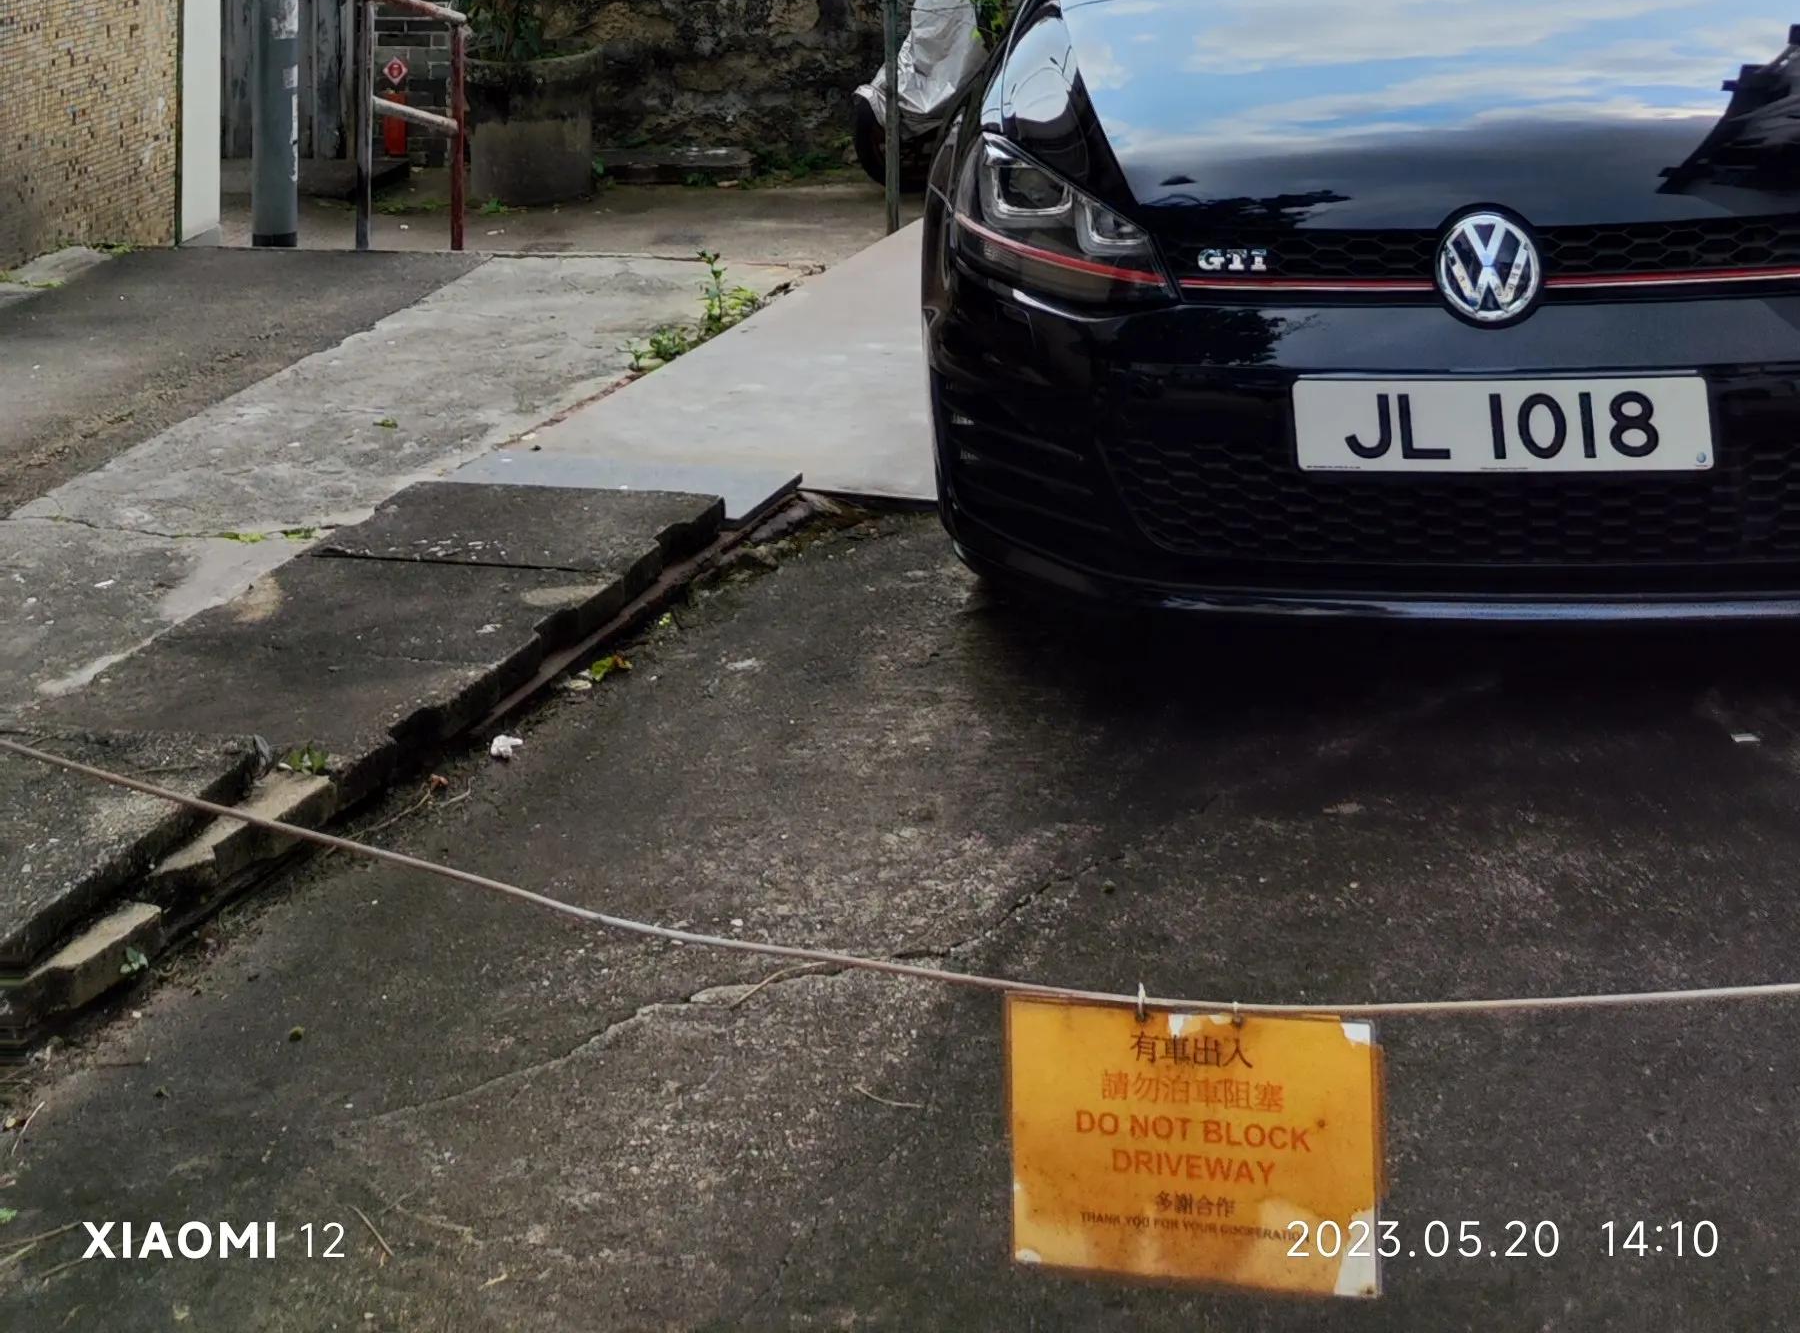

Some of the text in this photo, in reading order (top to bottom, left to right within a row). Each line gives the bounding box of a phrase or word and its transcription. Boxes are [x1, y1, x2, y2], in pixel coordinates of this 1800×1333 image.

[1197, 248, 1267, 271] GTI
[1344, 391, 1660, 460] JL 1018
[1130, 1031, 1254, 1069] 有車出入
[1101, 1069, 1285, 1113] 請勿泊車阻塞
[1075, 1110, 1311, 1153] DO NOT BLOCK
[1112, 1148, 1276, 1187] DRIVEWAY
[1155, 1191, 1236, 1218] 多謝合作
